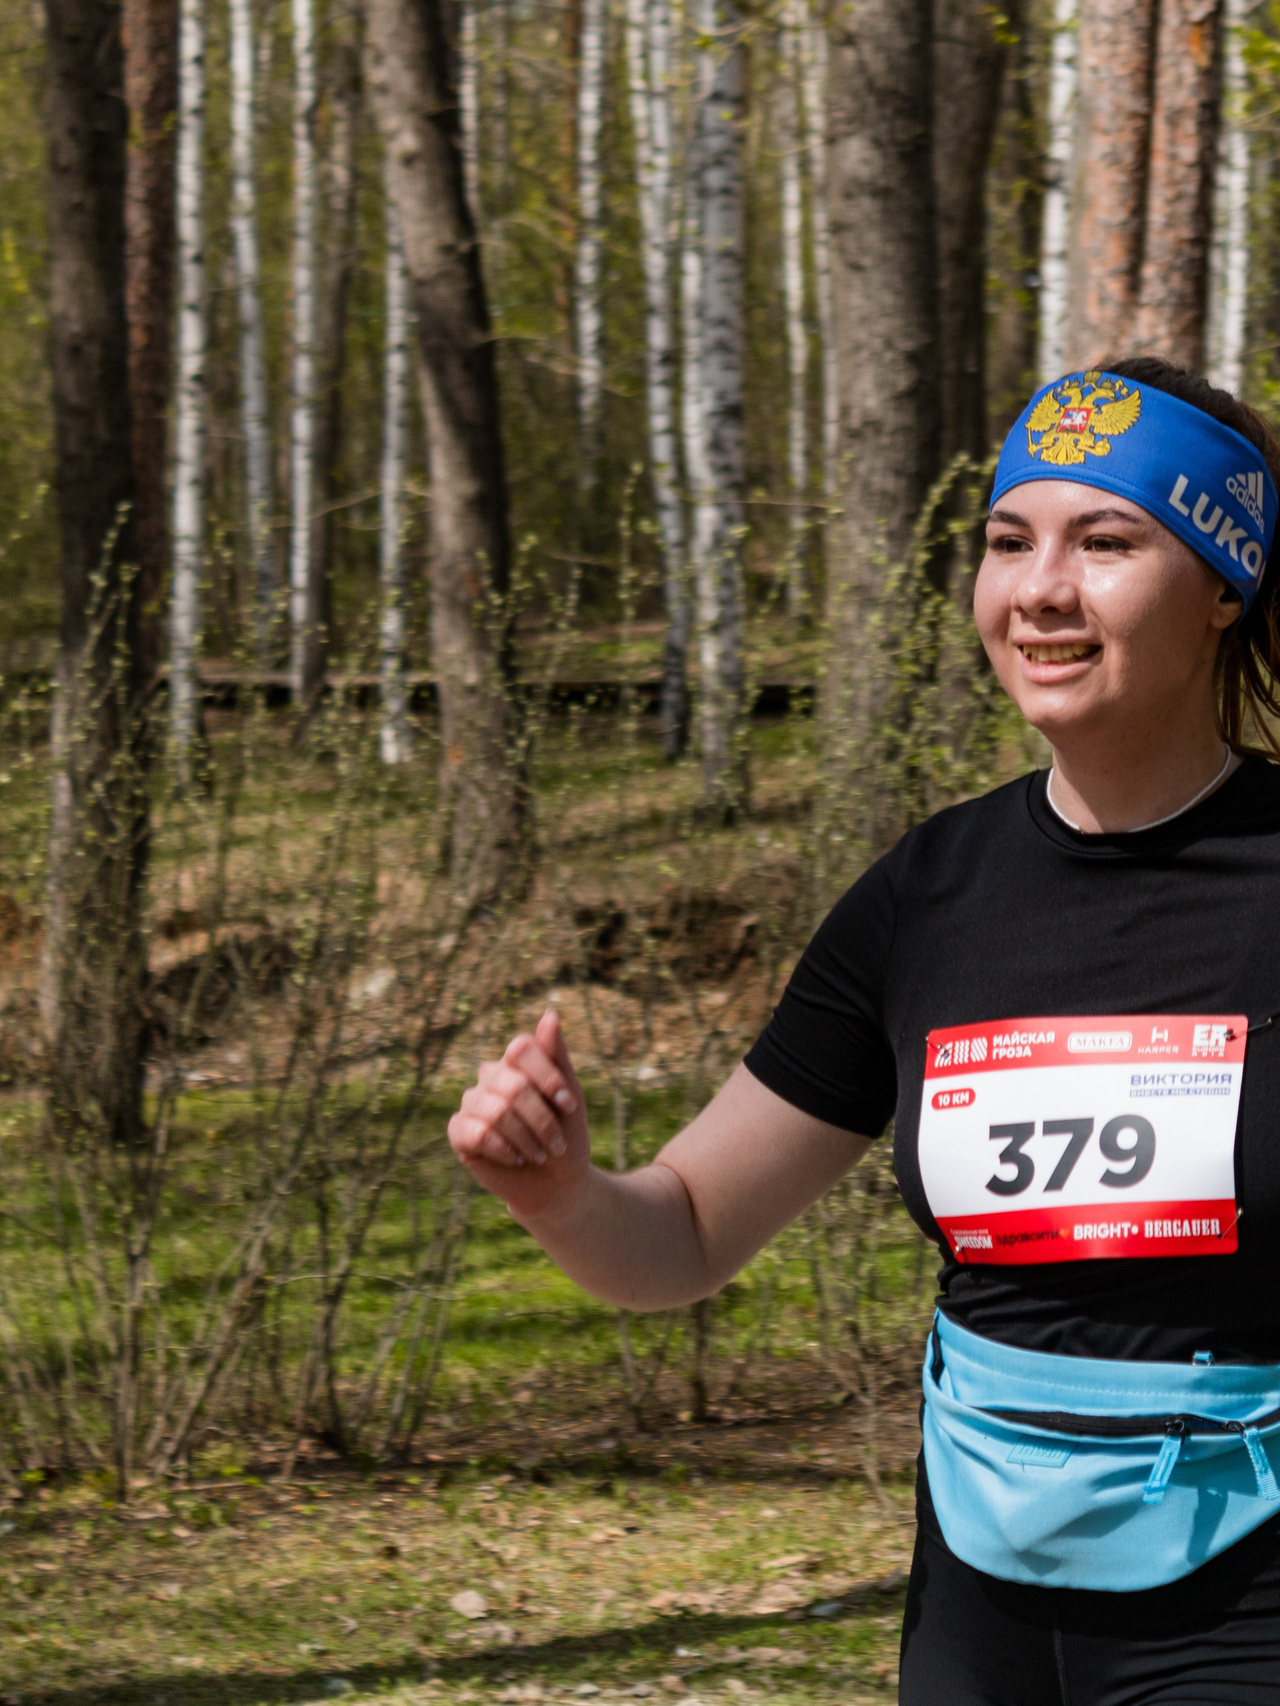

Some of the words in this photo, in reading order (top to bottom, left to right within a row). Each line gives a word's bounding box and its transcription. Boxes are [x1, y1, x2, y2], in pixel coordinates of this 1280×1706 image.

[1226, 476, 1265, 534] adidas
[992, 1031, 1056, 1048] МАЙСКАЯ
[1075, 1037, 1125, 1047] MAKFA
[991, 1045, 1032, 1061] ГРОЗА
[1129, 1073, 1233, 1086] ВИКТОРИЯ
[937, 1093, 951, 1107] 10
[985, 1114, 1156, 1197] 379
[1144, 1218, 1221, 1239] BERGAUER
